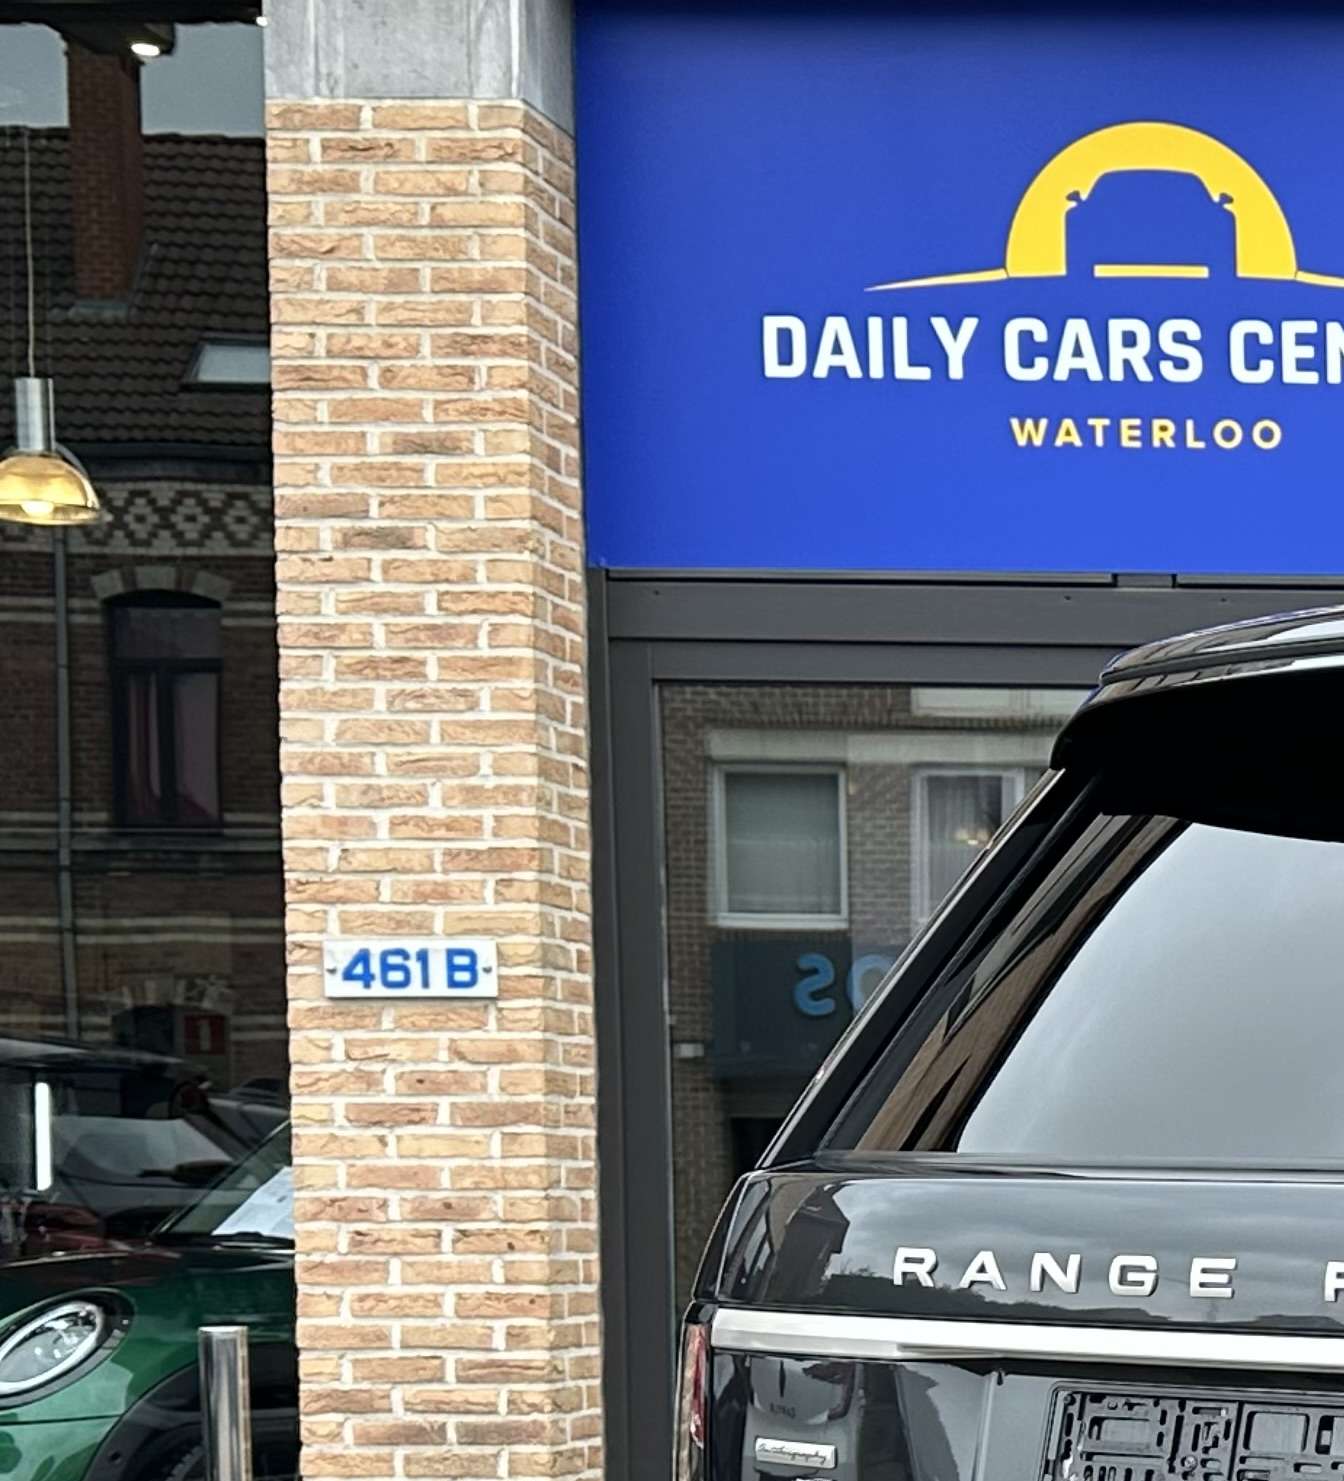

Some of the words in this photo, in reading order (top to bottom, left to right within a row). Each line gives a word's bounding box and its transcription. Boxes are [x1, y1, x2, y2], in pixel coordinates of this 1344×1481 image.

[762, 314, 979, 381] DAILY
[1003, 317, 1203, 384] CARS
[1010, 417, 1283, 450] WATERLOO
[341, 947, 430, 989] 461
[445, 947, 479, 989] B
[893, 1246, 1240, 1298] RANGE
